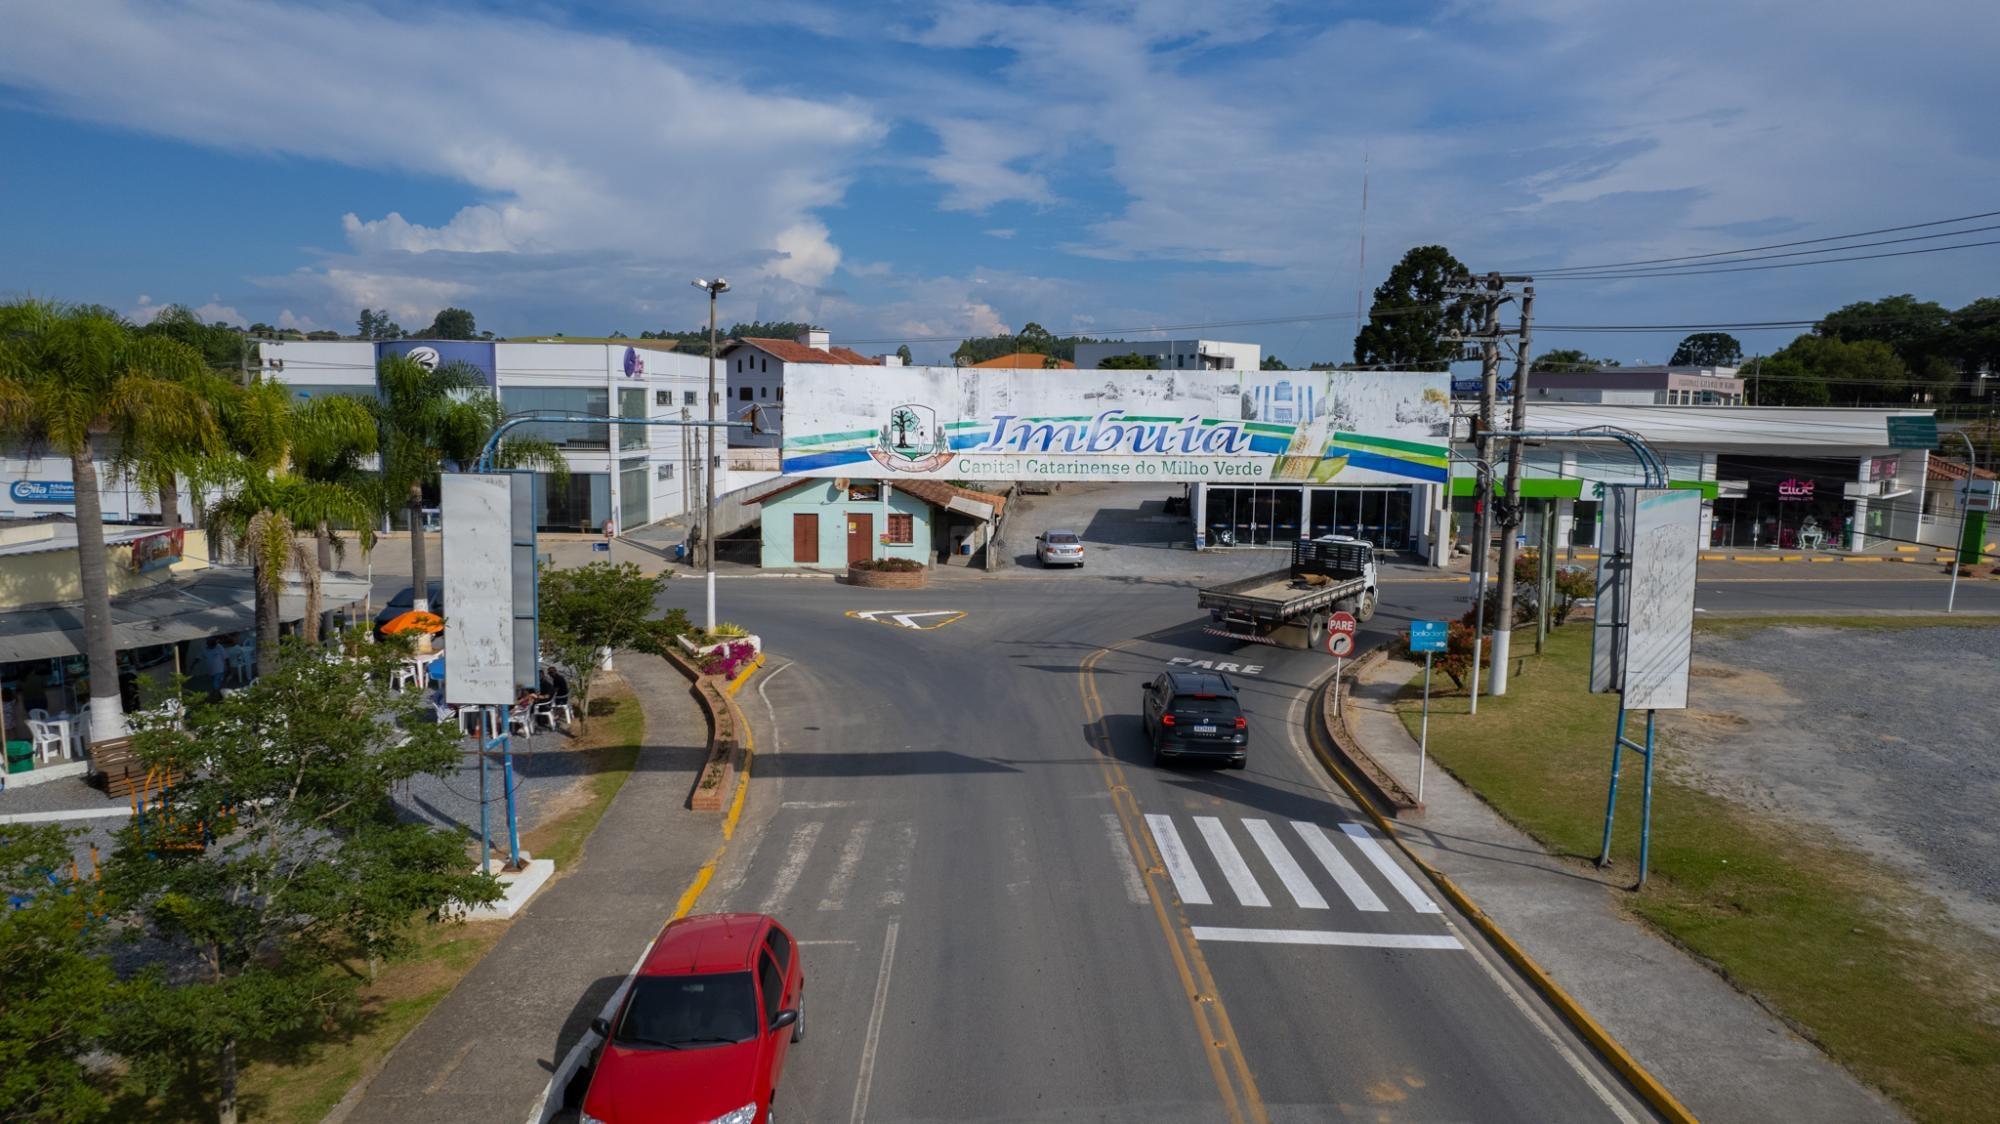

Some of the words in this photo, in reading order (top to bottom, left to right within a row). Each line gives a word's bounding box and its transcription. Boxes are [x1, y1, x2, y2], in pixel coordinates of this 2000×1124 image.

[959, 459, 1021, 476] Capital
[1026, 460, 1130, 475] Catarinense
[1135, 461, 1156, 475] do
[1161, 461, 1209, 476] Milho
[1213, 461, 1263, 476] Verde
[1329, 620, 1354, 632] PARE
[1166, 657, 1265, 674] PARE
